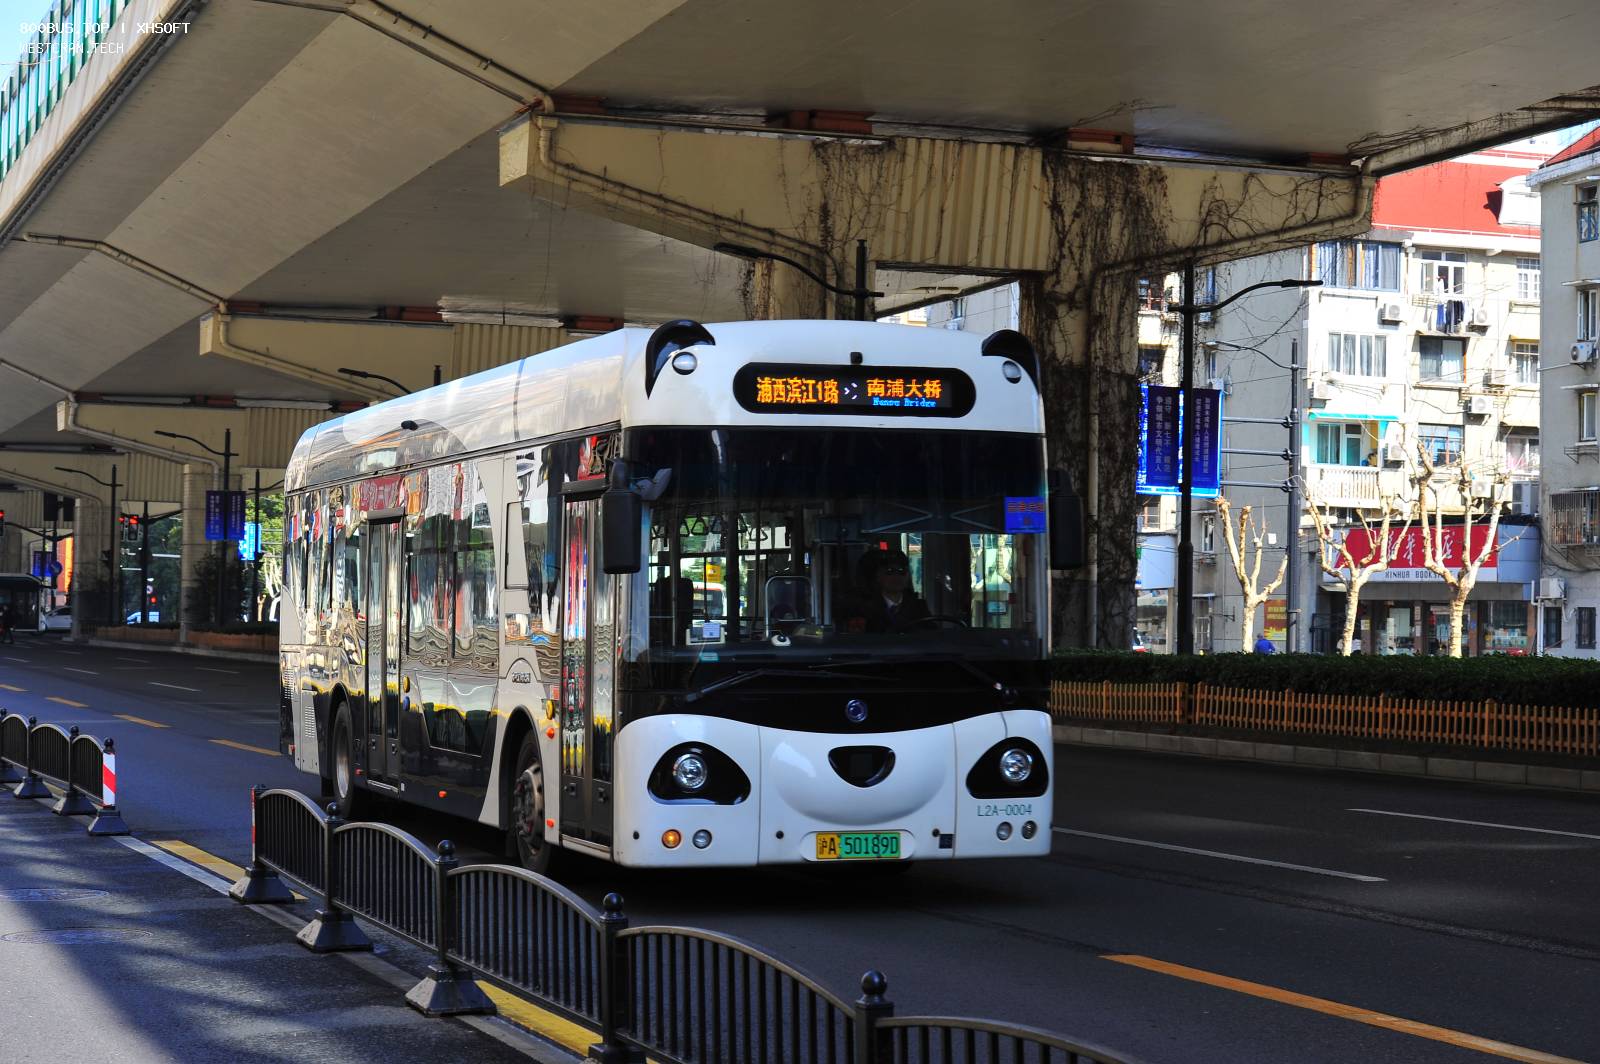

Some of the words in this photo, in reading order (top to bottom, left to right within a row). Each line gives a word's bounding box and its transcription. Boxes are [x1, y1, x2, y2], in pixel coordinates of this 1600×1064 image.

[756, 376, 839, 404] 浦西滨江1路
[866, 378, 943, 399] 南浦大桥
[1385, 570, 1410, 579] XINHUA
[977, 804, 1033, 817] L2A-0004
